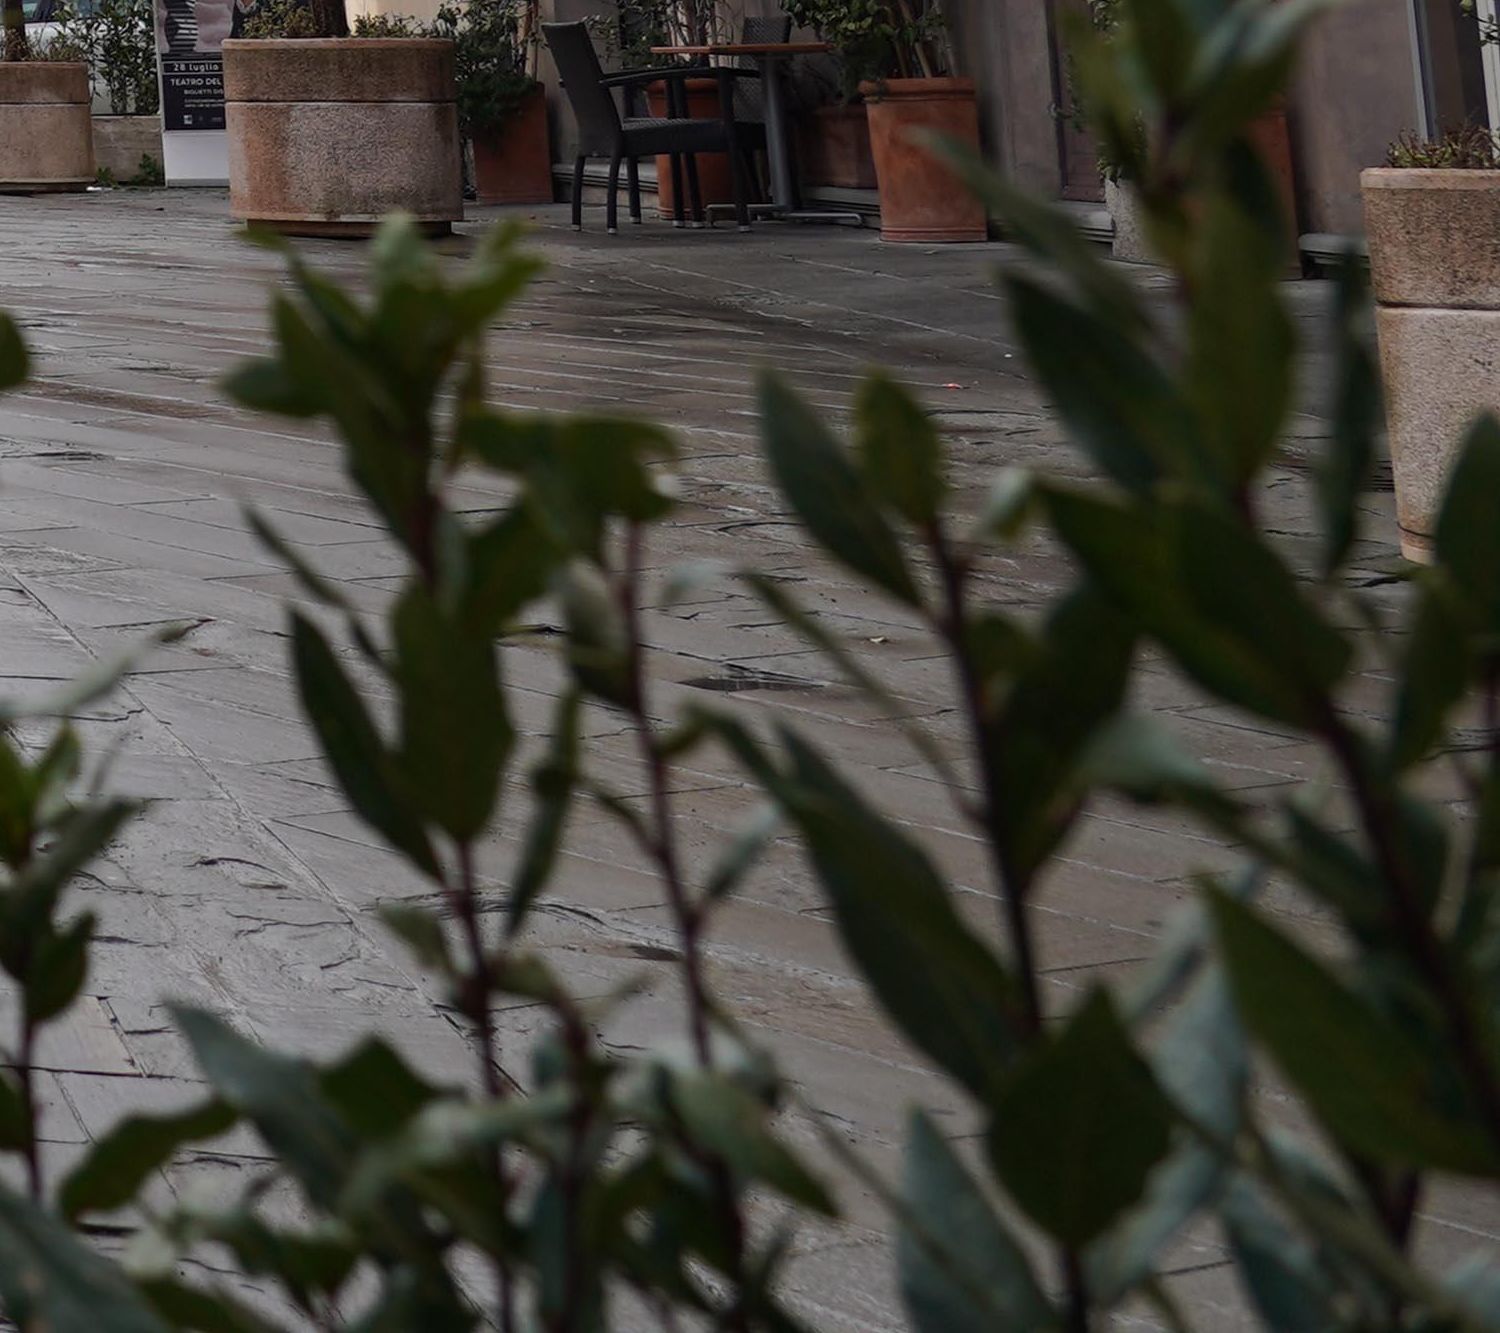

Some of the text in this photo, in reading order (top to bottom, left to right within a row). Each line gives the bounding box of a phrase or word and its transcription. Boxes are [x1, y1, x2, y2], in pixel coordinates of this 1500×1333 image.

[173, 63, 220, 73] 28 luglio
[170, 78, 221, 86] TEATRO DEL
